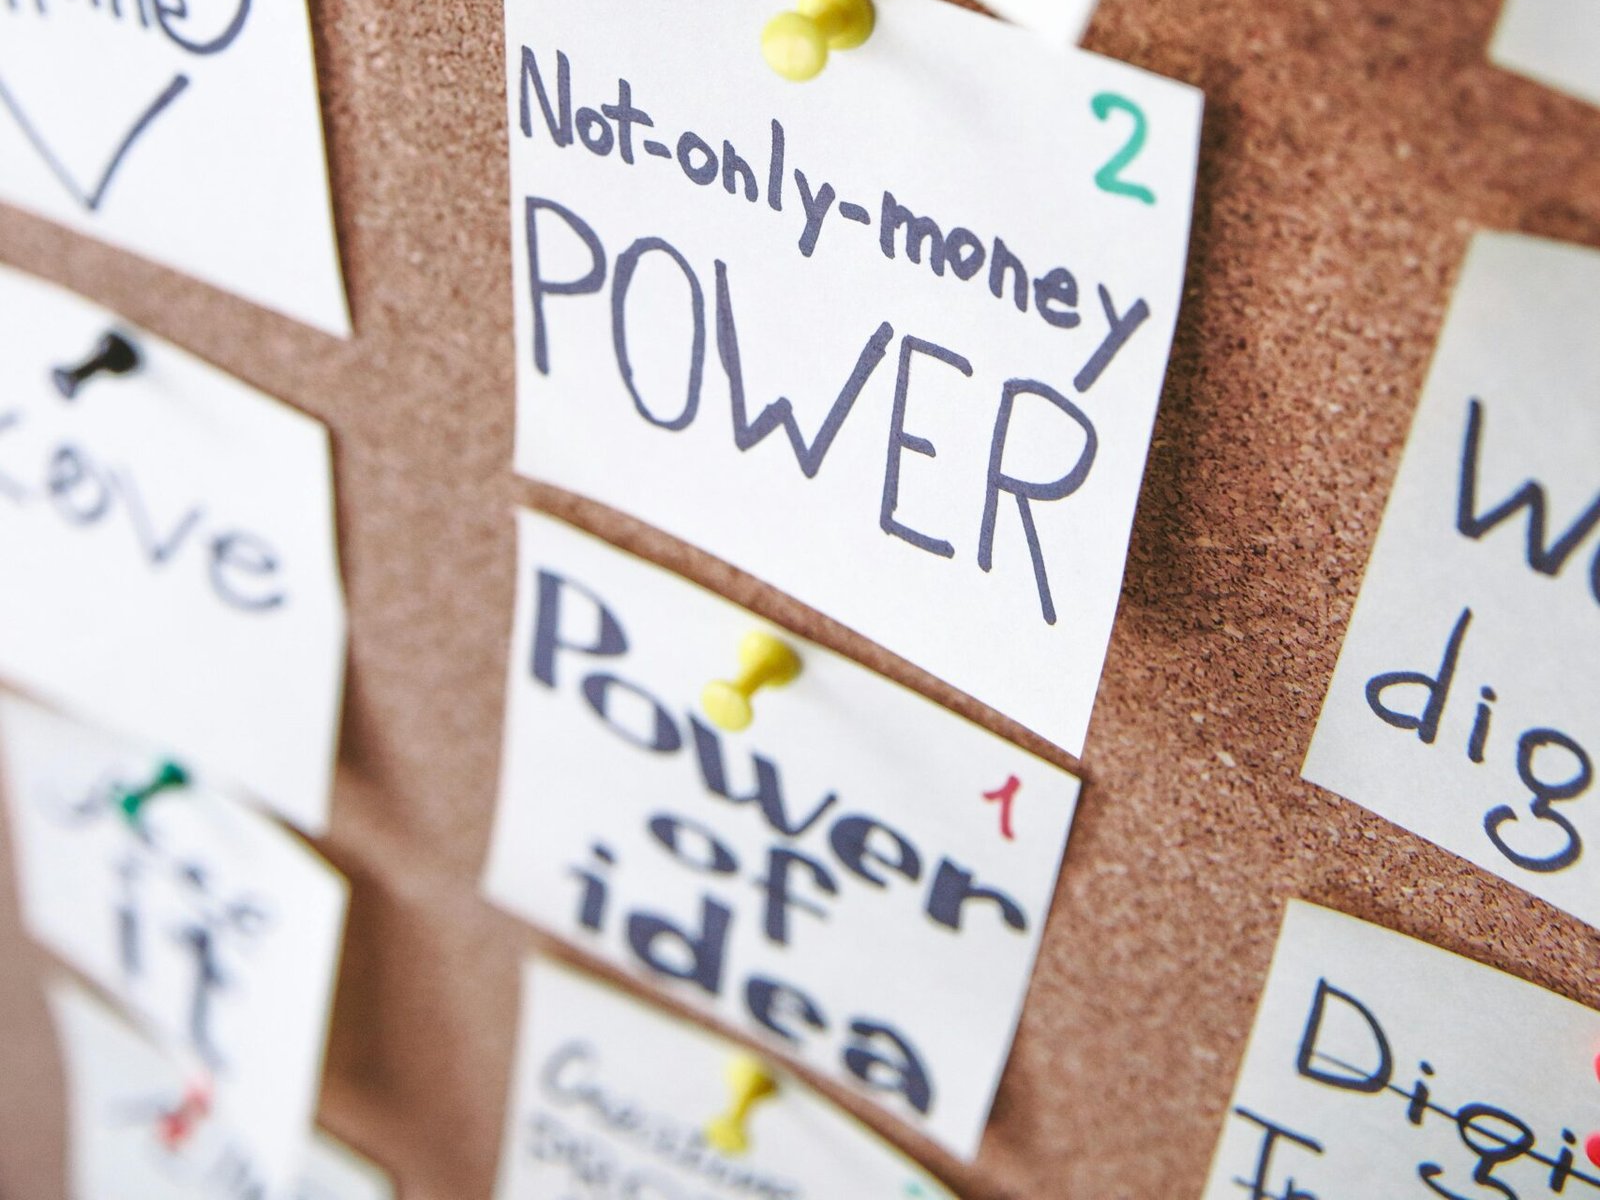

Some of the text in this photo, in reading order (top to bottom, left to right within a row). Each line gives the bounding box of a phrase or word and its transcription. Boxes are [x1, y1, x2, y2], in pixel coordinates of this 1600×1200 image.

[520, 43, 1150, 394] Not-only-money
[1089, 90, 1157, 206] 2
[524, 195, 1099, 626] POWER
[1457, 397, 1600, 608] W
[530, 567, 1029, 936] Power
[979, 772, 1023, 842] 1
[1366, 606, 1592, 872] dig
[565, 840, 935, 1117] idea
[645, 810, 841, 946] of
